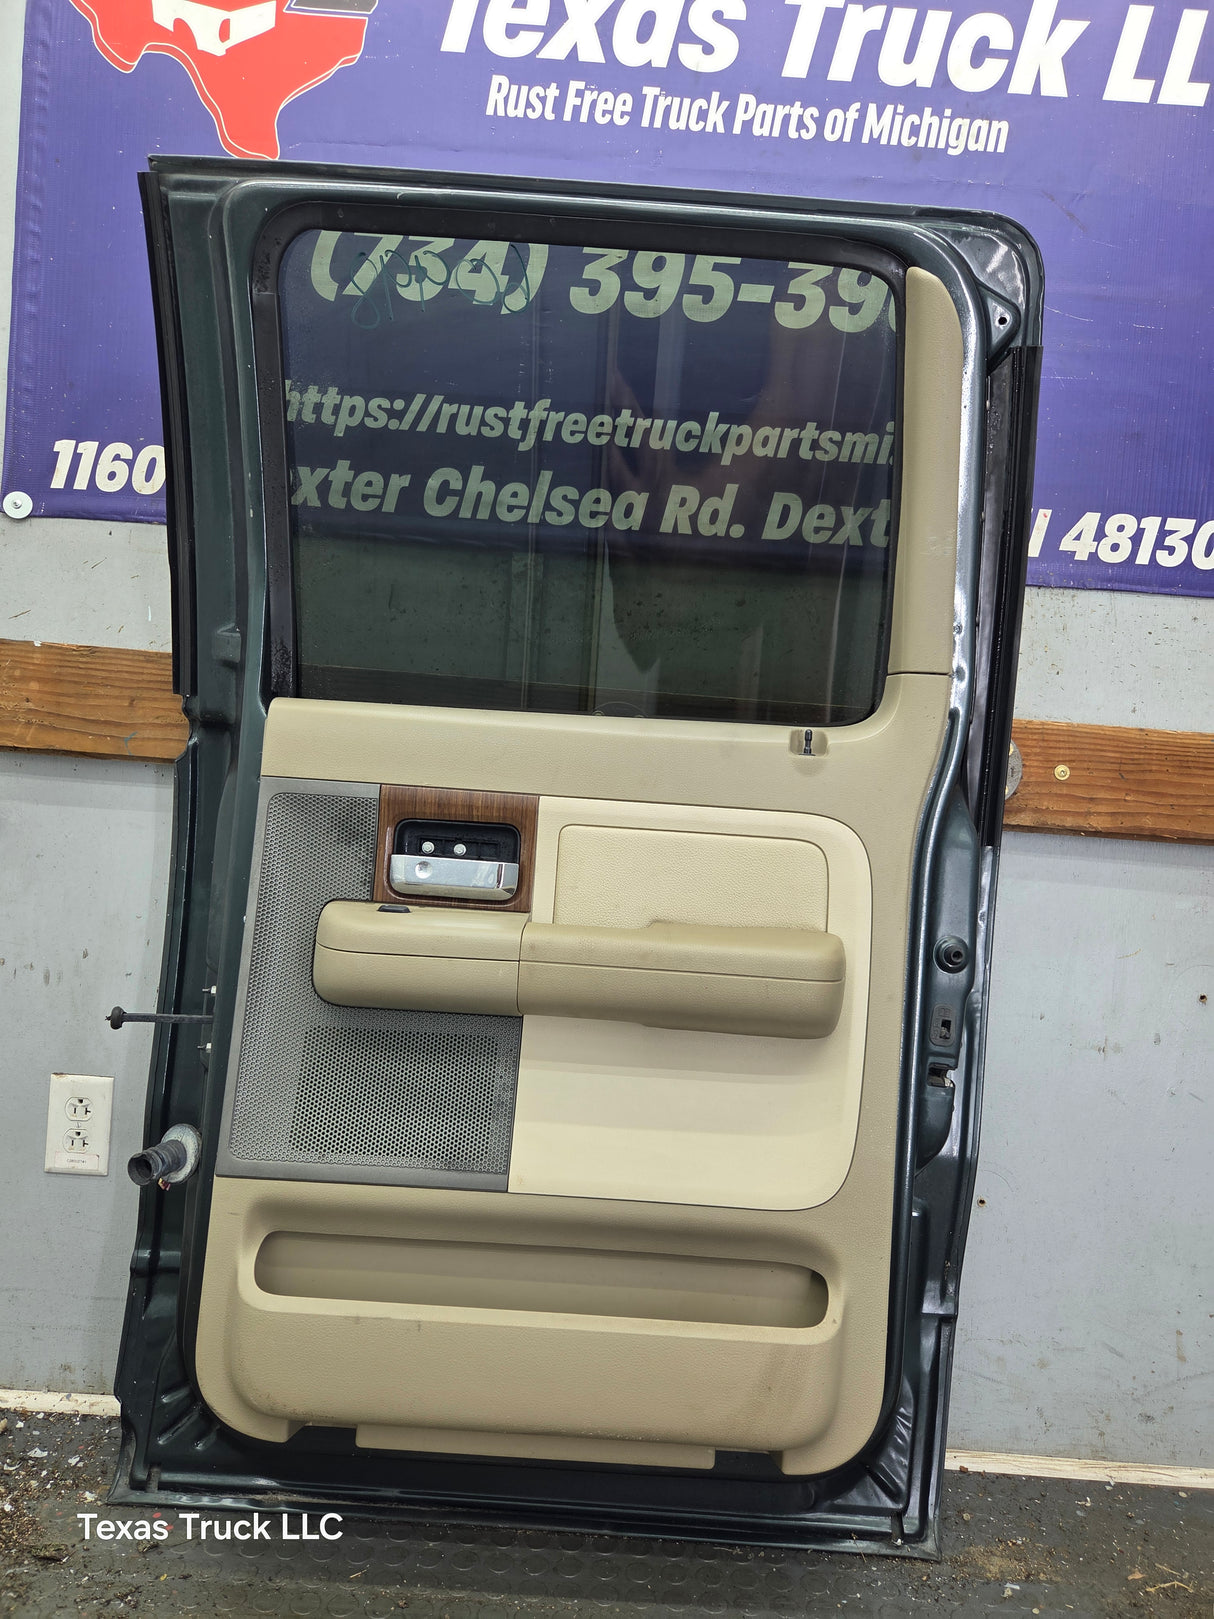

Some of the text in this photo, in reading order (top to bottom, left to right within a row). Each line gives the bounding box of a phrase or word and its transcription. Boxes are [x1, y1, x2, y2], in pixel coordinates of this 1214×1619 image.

[440, 0, 1211, 107] Texas Truck LL
[485, 74, 1010, 155] Rust Free Truck Parts of Michigan
[311, 230, 896, 333] (734) 395-39
[284, 379, 895, 466] https://rustfreetruckpartsmi
[50, 439, 1214, 570] 1160 xter Chelsea Rd. Dext I 48130
